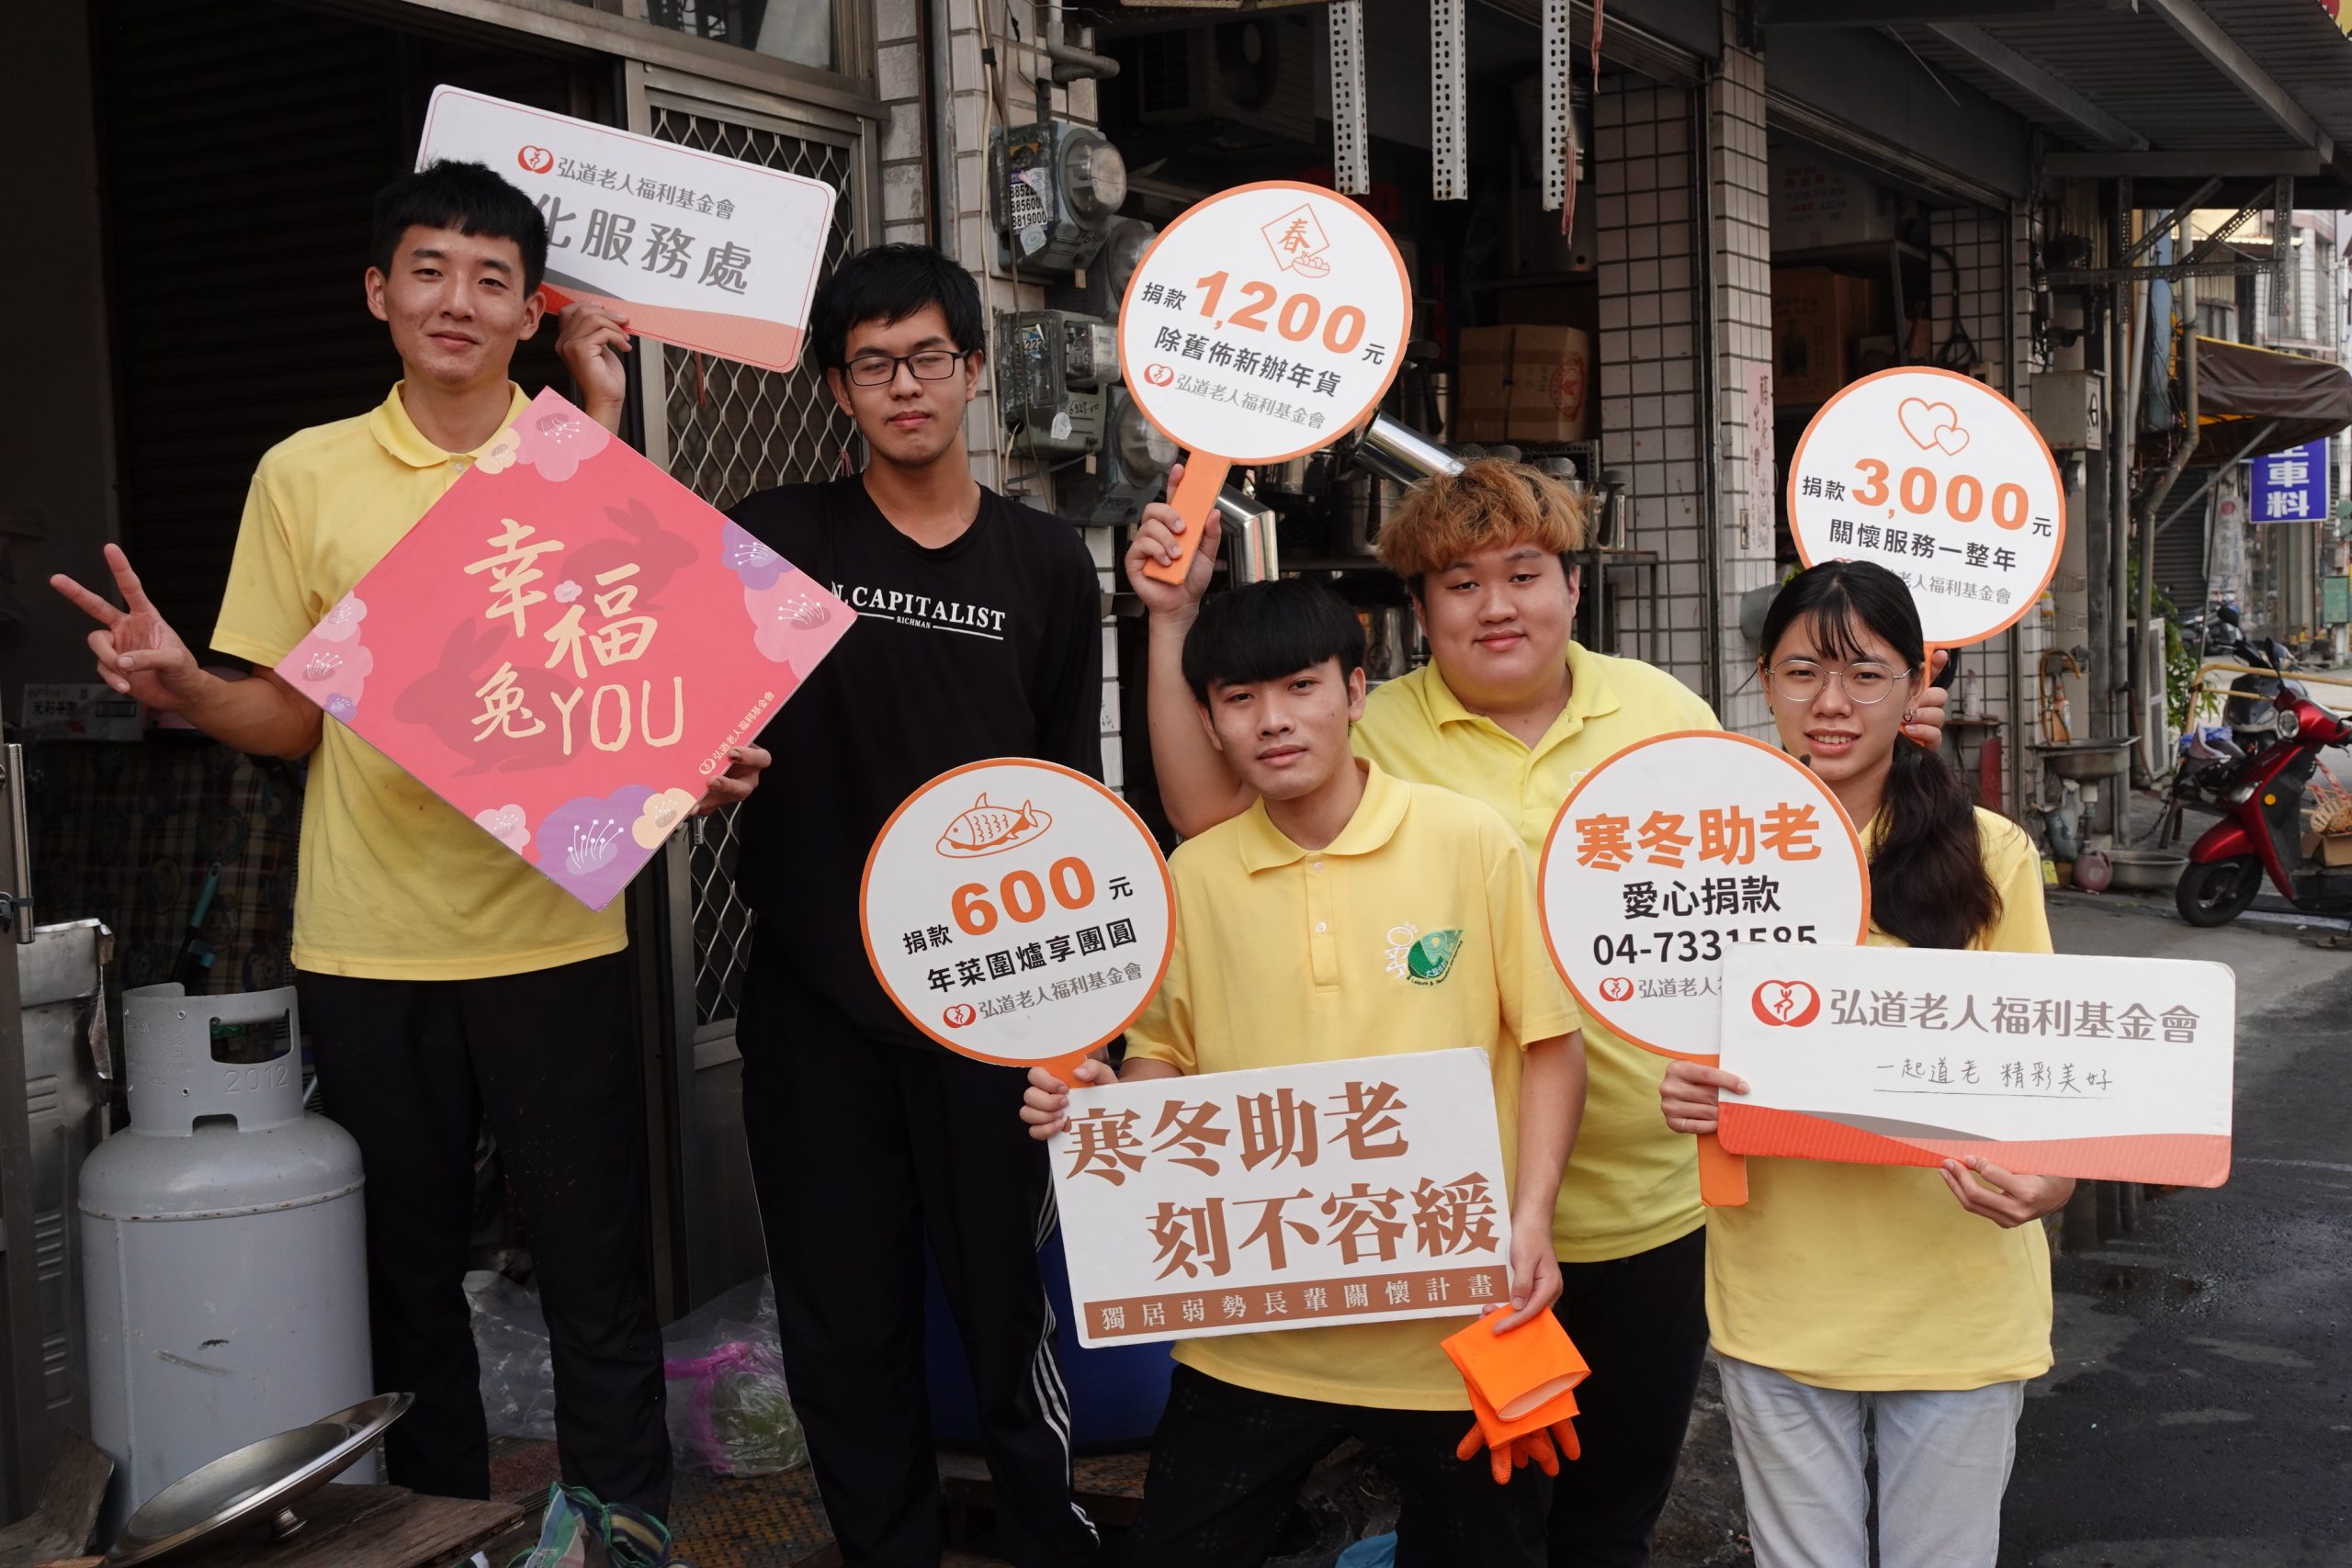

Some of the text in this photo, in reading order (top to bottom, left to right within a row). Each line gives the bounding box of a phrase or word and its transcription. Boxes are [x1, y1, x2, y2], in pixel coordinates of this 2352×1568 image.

[557, 156, 736, 220] 弘道老人福利基金會
[1277, 217, 1312, 254] 春
[1141, 270, 1385, 366] 捐款 1,200 元
[1154, 325, 1342, 398] 除舊佈新辦年貨
[1174, 373, 1326, 430] 弘道老人福利基金會
[1802, 458, 2052, 537] 捐款 3,000 元
[1828, 518, 2017, 572] 關懷服務一整年
[463, 517, 659, 680] 幸福
[852, 585, 1006, 632] CAPITALIST
[1893, 570, 2011, 604] 老人福利基金會
[896, 615, 932, 630] RICHMAN
[713, 691, 775, 761] 弘道老人福利基金會
[1575, 801, 1822, 873] 寒冬助老
[902, 856, 1134, 955] 捐款 600 元
[1623, 874, 1781, 919] 愛心捐款
[926, 918, 1138, 995] 年菜圍爐享團圓
[978, 962, 1143, 1020] 弘道老人福利基金會
[1829, 988, 2201, 1044] 弘道老人福利基金會
[223, 1064, 289, 1095] 2012
[1876, 1057, 2113, 1094] 一起道老 精彩美好
[1062, 1080, 1409, 1187] 寒冬助老
[1145, 1171, 1500, 1282] 刻不容緩
[1101, 1273, 1494, 1332] 獨居弱勢長輩關懷計畫
